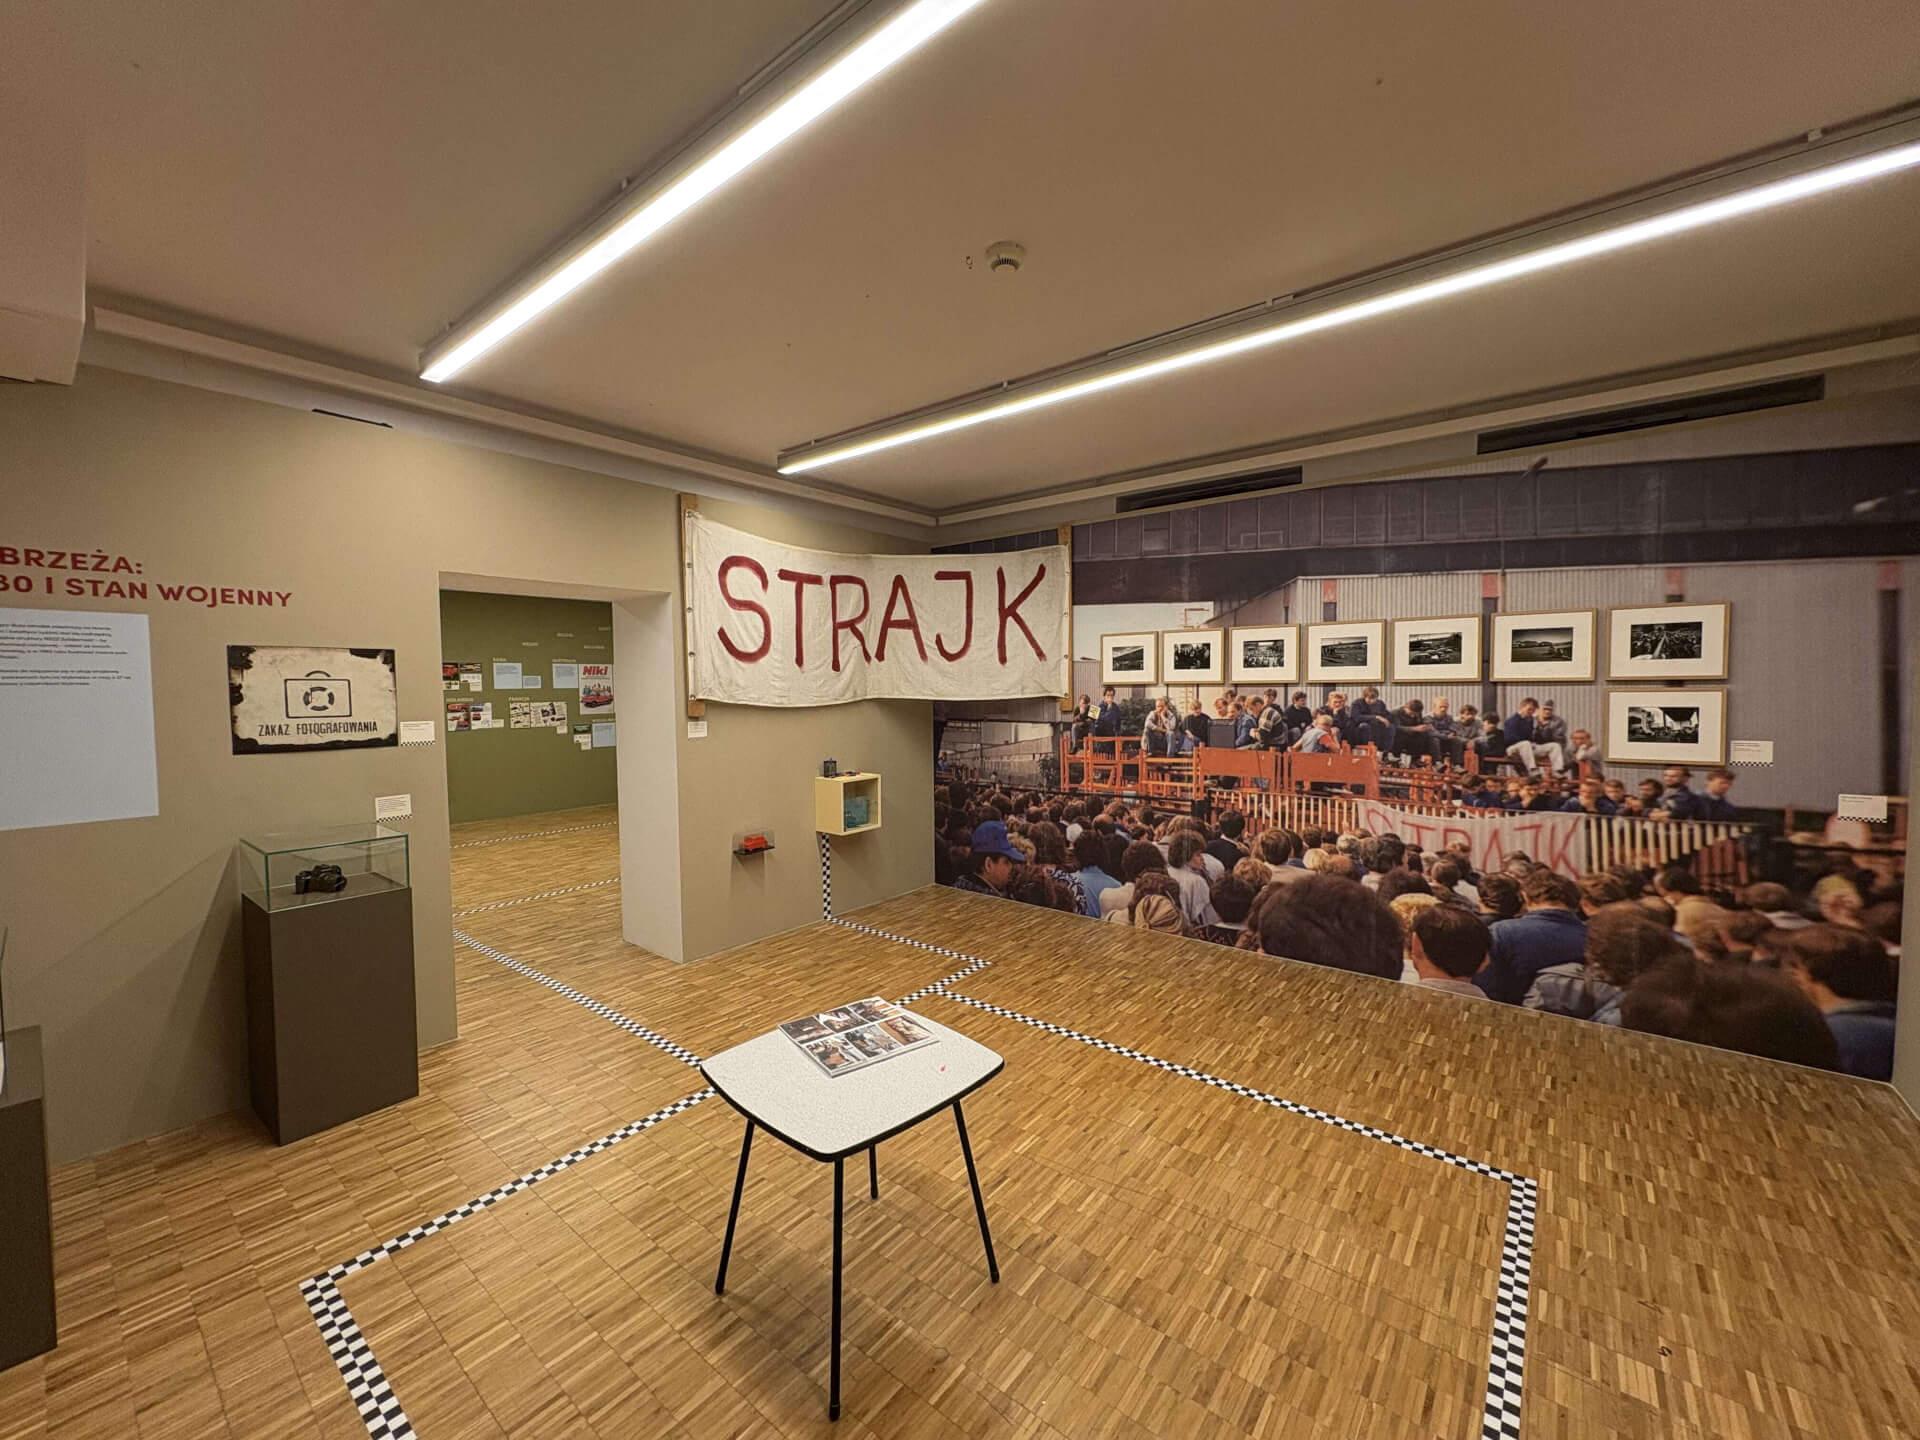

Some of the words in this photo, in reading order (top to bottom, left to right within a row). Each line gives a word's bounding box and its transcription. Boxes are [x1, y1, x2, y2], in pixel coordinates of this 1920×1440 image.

[0, 546, 142, 574] BRZEŻA:
[45, 577, 53, 594] I
[65, 578, 148, 599] STAN
[156, 583, 292, 608] WOJENNY
[717, 555, 1047, 672] STRAJK
[583, 665, 608, 676] Niki
[258, 724, 291, 737] ZAKAZ
[296, 721, 378, 735] FOTOGRAFOWANIA
